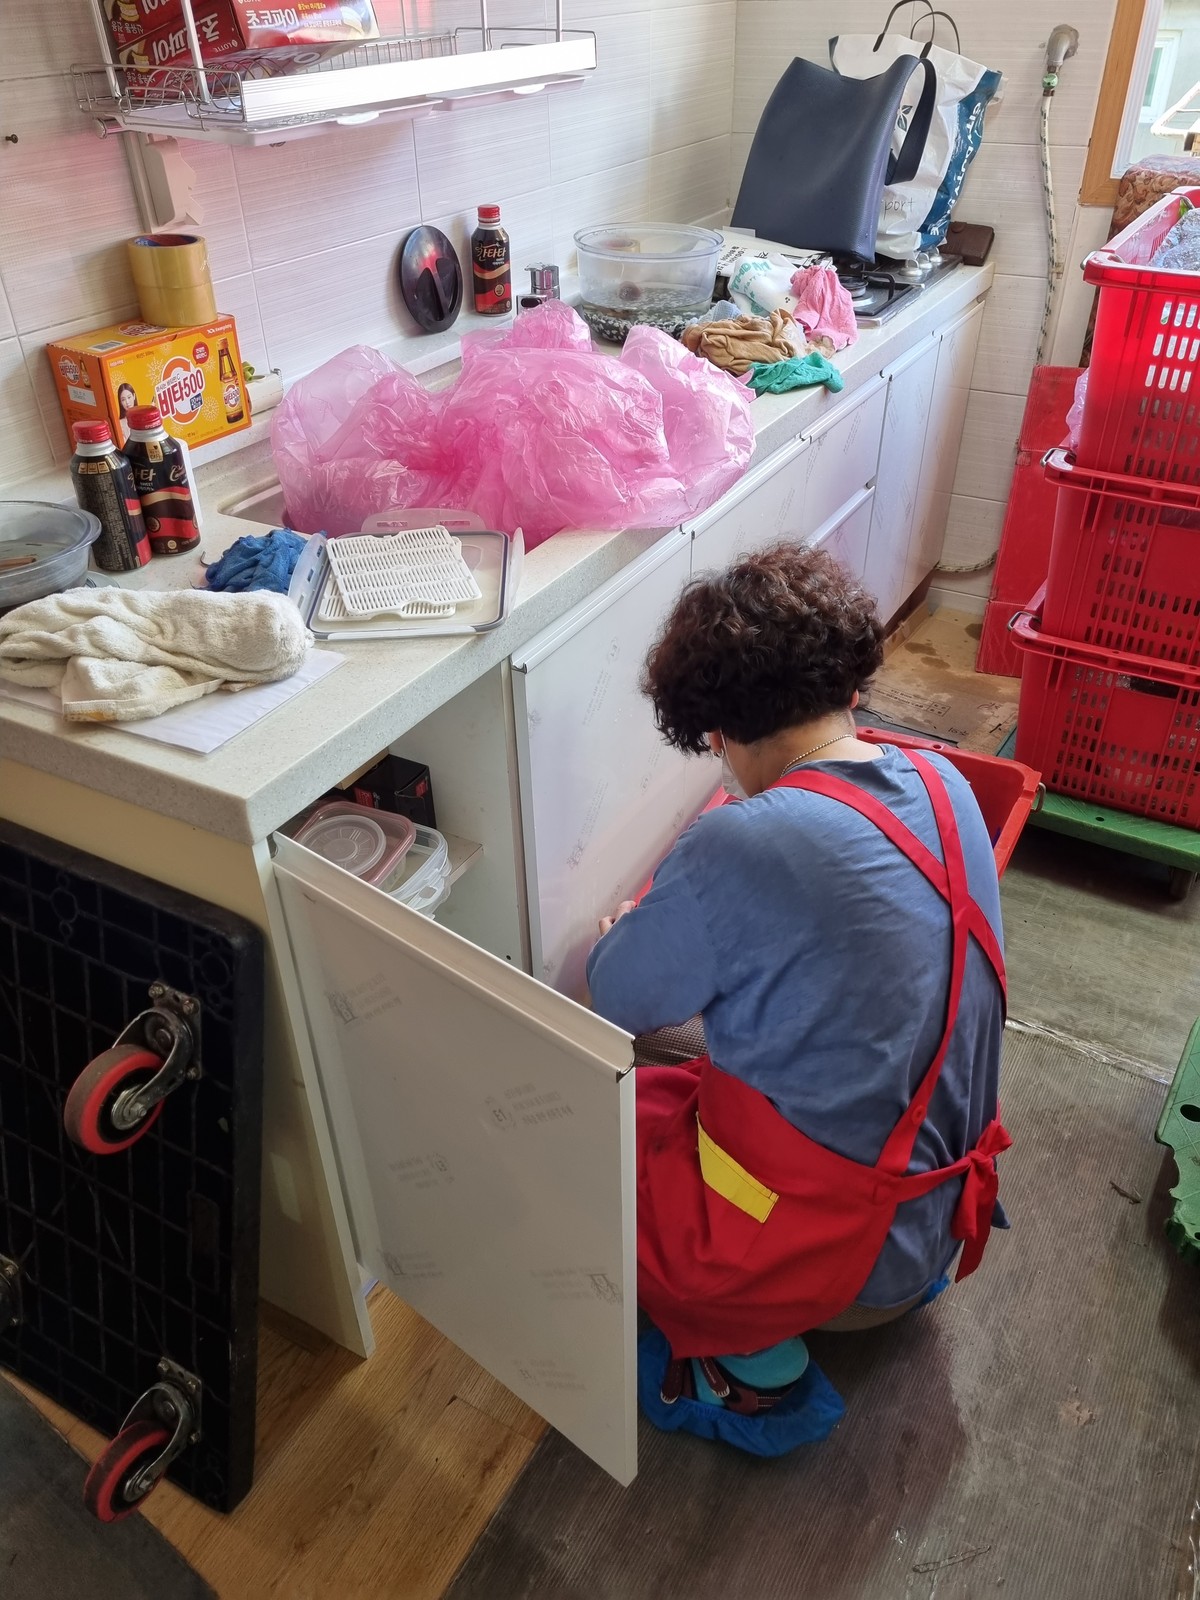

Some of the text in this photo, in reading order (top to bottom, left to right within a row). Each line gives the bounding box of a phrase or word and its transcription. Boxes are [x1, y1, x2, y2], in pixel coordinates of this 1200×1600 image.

[246, 8, 300, 29] 초코파이
[213, 41, 233, 53] LOTTE
[157, 369, 205, 417] 비타500
